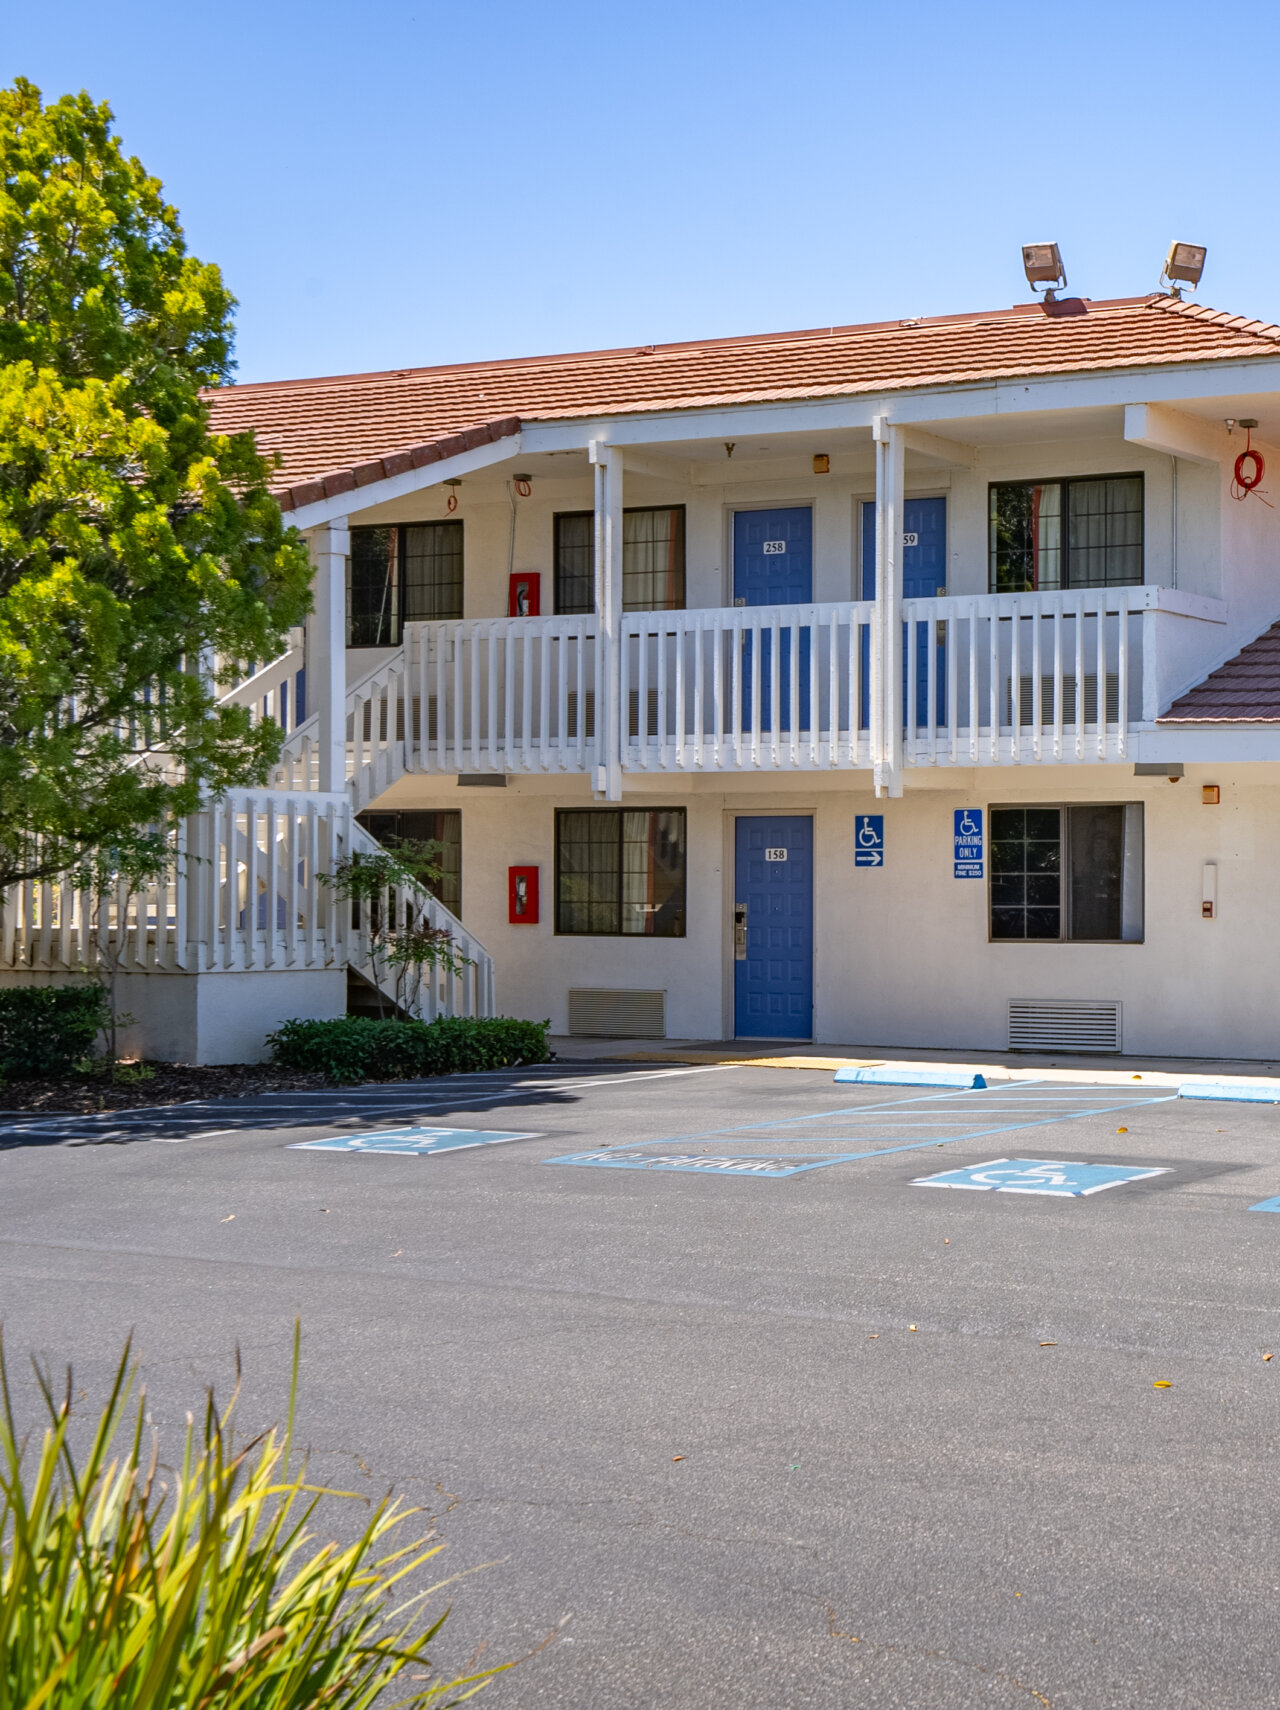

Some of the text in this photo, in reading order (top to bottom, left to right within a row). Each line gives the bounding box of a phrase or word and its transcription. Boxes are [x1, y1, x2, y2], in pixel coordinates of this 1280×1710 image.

[903, 535, 915, 544] 59
[766, 543, 783, 553] 258
[955, 836, 982, 845] PARKING
[767, 850, 785, 859] 158
[959, 847, 977, 857] ONLY
